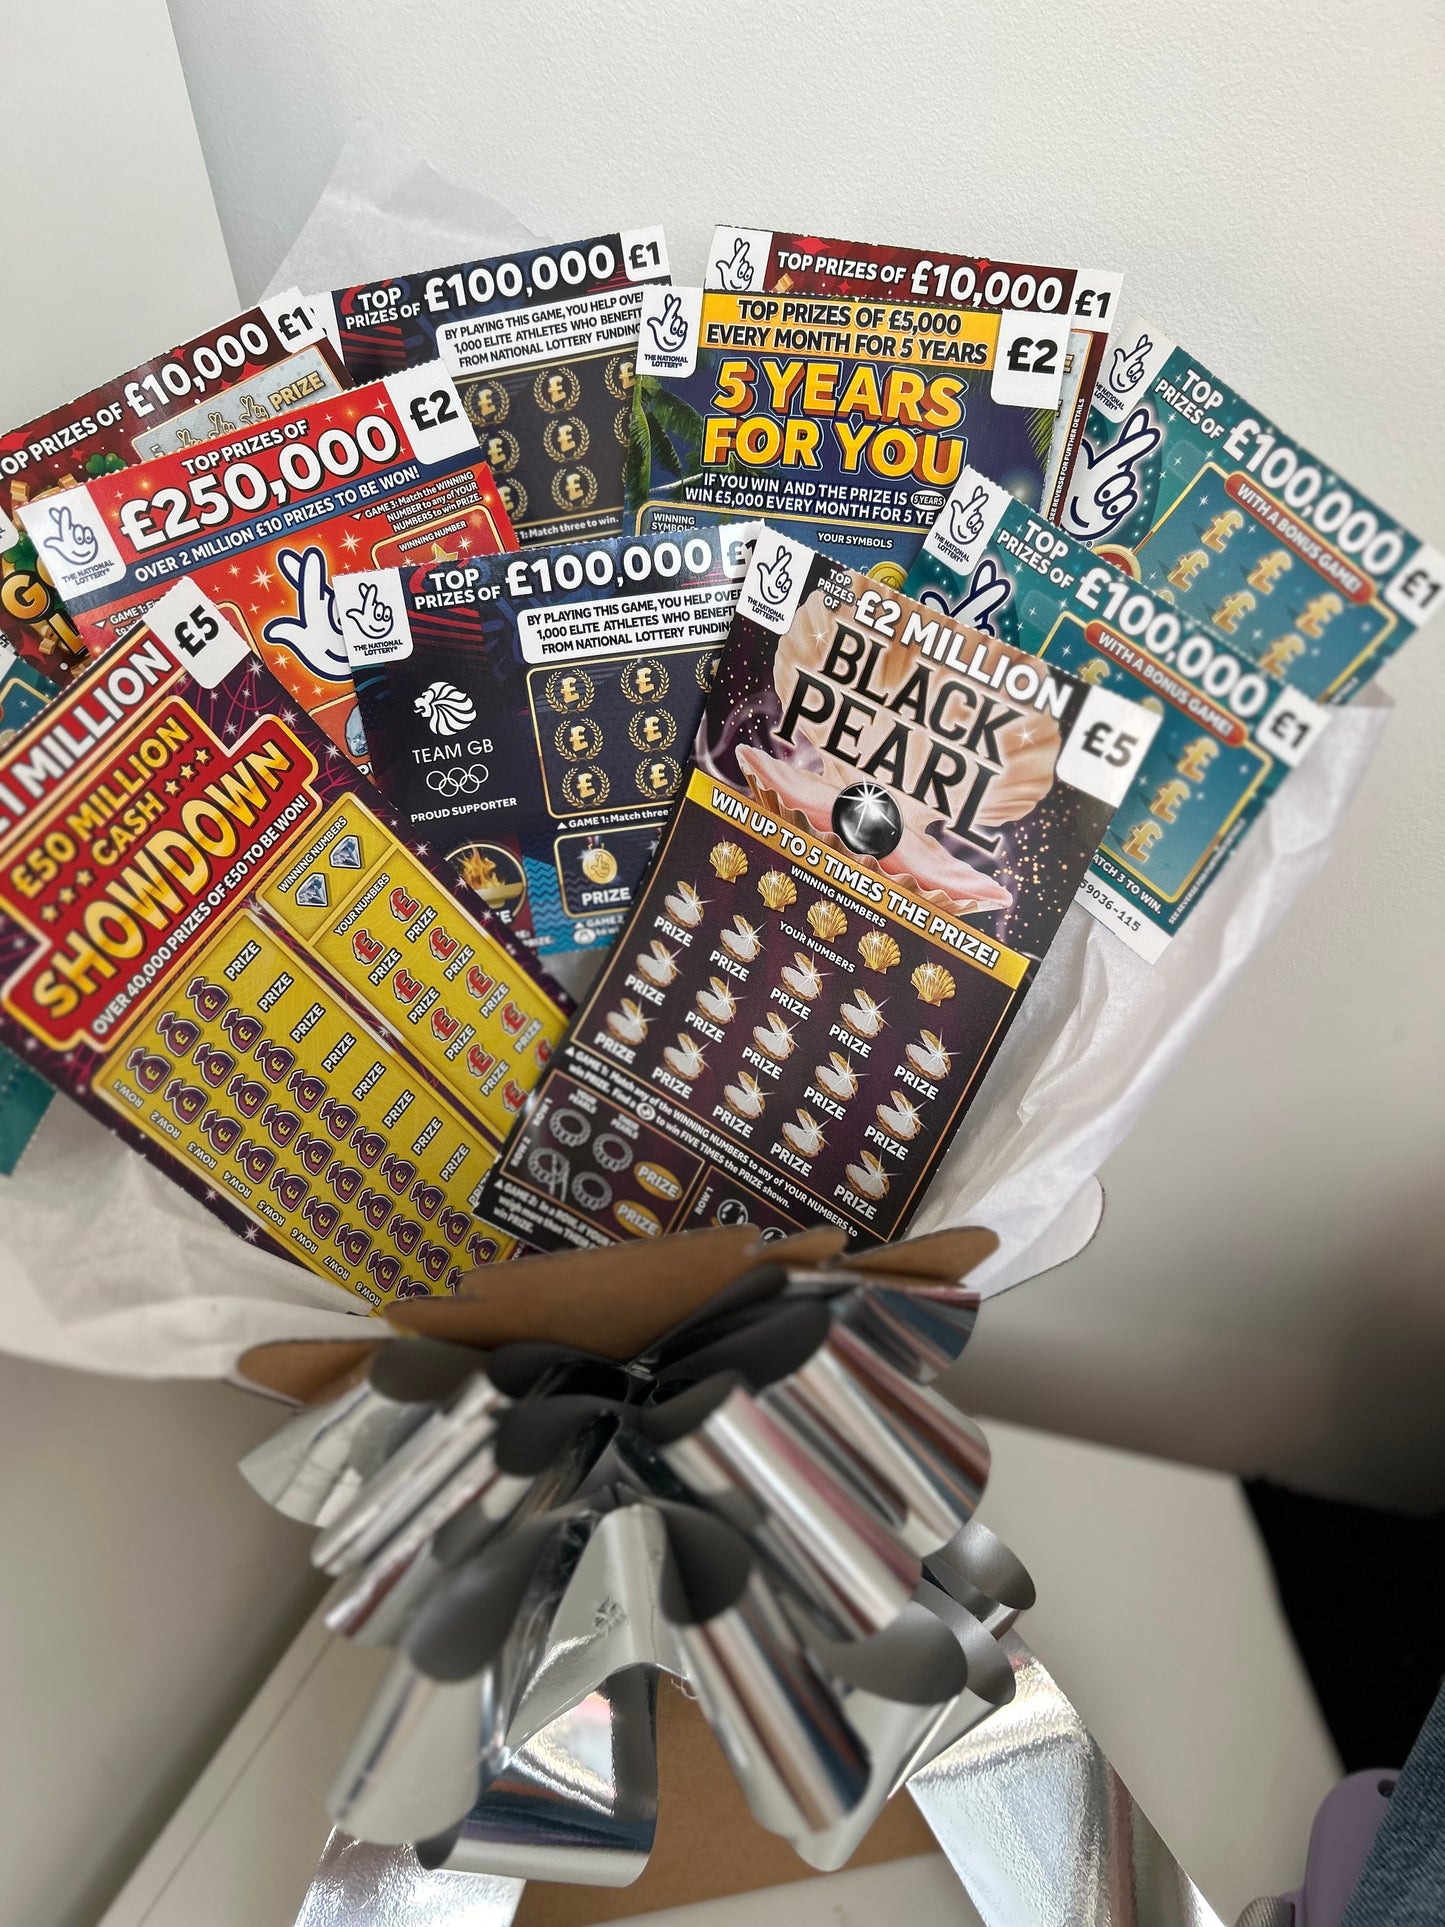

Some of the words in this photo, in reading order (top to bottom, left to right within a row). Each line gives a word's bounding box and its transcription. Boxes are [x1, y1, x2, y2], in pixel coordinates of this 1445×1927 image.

[629, 242, 660, 269] £1
[424, 245, 615, 312] £100,000
[777, 251, 813, 272] TOP
[814, 256, 878, 280] PRIZES
[881, 266, 907, 284] OF
[911, 260, 1063, 311] £10,000
[1074, 289, 1111, 318] £1
[345, 309, 398, 330] PRIZES
[357, 288, 402, 311] TOP
[400, 303, 420, 318] OF
[738, 299, 778, 321] TOP
[782, 303, 850, 326] PRIZES
[856, 307, 885, 328] OF
[889, 310, 961, 335] £5,000
[706, 324, 770, 346] EVERY
[774, 328, 850, 353] MONTH
[855, 334, 896, 355] FOR
[900, 339, 913, 356] 5
[919, 338, 987, 364] YEARS
[1006, 336, 1058, 375] £2
[28, 417, 98, 461] PRIZES
[96, 403, 123, 427] OF
[124, 323, 268, 418] £10,000
[277, 307, 313, 341] £1
[268, 371, 325, 411] PRIZE
[714, 360, 760, 416] 5
[759, 361, 969, 430] YEARS
[1154, 378, 1201, 424] PRIZES
[1184, 369, 1223, 409] TOP
[181, 451, 221, 476] TOP
[221, 433, 284, 465] PRIZES
[283, 419, 309, 440] OF
[1201, 416, 1225, 440] OF
[119, 415, 399, 552] £250,000
[409, 390, 459, 432] £2
[703, 415, 823, 468] FOR
[828, 420, 967, 487] YOU
[1049, 502, 1057, 521] SEE
[1053, 474, 1065, 506] REVERSE
[1064, 430, 1076, 461] FURTHER
[1073, 399, 1084, 430] DETAILS
[365, 505, 390, 518] GAME
[400, 493, 424, 506] Match
[424, 488, 436, 496] the
[436, 472, 474, 490] WINNING
[704, 473, 716, 486] IF
[719, 474, 748, 489] YOU
[751, 478, 780, 493] WIN
[784, 481, 816, 496] AND
[819, 483, 847, 500] THE
[850, 488, 889, 505] PRIZE
[892, 491, 907, 505] IS
[1222, 418, 1403, 577] £100,000
[134, 556, 177, 584] OVER
[178, 552, 191, 567] 2
[192, 529, 253, 563] MILLION
[255, 518, 283, 541] £10
[284, 495, 334, 530] PRIZES
[334, 489, 357, 509] TO
[358, 481, 379, 499] BE
[379, 466, 420, 490] WON!
[399, 535, 434, 552] WINNING
[434, 521, 466, 539] NUMBER
[818, 532, 846, 544] YOUR
[846, 535, 893, 549] SYMBOLS
[1025, 520, 1069, 560] TOP
[505, 539, 712, 597] £100,000
[996, 530, 1049, 578] PRIZES
[430, 568, 480, 590] TOP
[478, 586, 501, 601] OF
[817, 577, 855, 604] PRIZES
[829, 567, 852, 585] TOP
[1049, 566, 1075, 589] OF
[1401, 568, 1441, 608] £1
[414, 590, 475, 610] PRIZES
[527, 615, 542, 626] BY
[544, 608, 592, 624] PLAYING
[593, 605, 619, 616] THIS
[621, 601, 658, 613] GAME,
[658, 597, 681, 609] YOU
[683, 594, 712, 605] HELP
[823, 595, 840, 609] OF
[855, 590, 902, 638] £2
[537, 626, 567, 640] 1,000
[569, 622, 600, 635] ELITE
[603, 615, 658, 631] ATHLETES
[661, 611, 690, 622] WHO
[541, 641, 576, 654] FROM
[576, 634, 632, 651] NATIONAL
[636, 628, 684, 642] LOTTERY
[1074, 566, 1269, 717] £100,000
[899, 612, 1073, 721] MILLION
[1098, 632, 1135, 663] WITH
[1132, 659, 1143, 672] A
[1143, 665, 1190, 704] BONUS
[10, 639, 172, 799] MILLION
[174, 604, 219, 658] £5
[820, 622, 1029, 766] BLACK
[1082, 721, 1138, 768] £5
[1269, 709, 1312, 747] £1
[412, 744, 462, 764] TEAM
[467, 739, 494, 754] GB
[775, 668, 1005, 852] PEARL
[10, 831, 75, 899] £50
[67, 716, 191, 841] MILLION
[92, 789, 166, 865] CASH
[410, 807, 450, 824] PROUD
[451, 798, 517, 817] SUPPORTER
[278, 854, 313, 894] WINNING
[309, 816, 348, 859] NUMBERS
[33, 741, 292, 1019] SHOWDOWN
[582, 887, 631, 906] PRIZE
[711, 788, 752, 824] WIN
[751, 812, 778, 837] UP
[778, 827, 807, 856] TO
[806, 844, 821, 867] 5
[824, 855, 884, 902] TIMES
[887, 889, 928, 929] THE
[928, 916, 1000, 968] PRIZE!
[791, 865, 837, 899] WINNING
[835, 892, 887, 928] NUMBERS
[1092, 853, 1119, 879] ATCH
[1117, 872, 1124, 883] 3
[1125, 877, 1140, 895] TO
[1140, 891, 1162, 914] WIN.
[92, 994, 132, 1035] OVER
[126, 947, 173, 999] 40,000
[167, 902, 212, 952] PRIZES
[208, 883, 227, 910] OF
[224, 860, 249, 892] £50
[243, 844, 264, 869] TO
[261, 827, 281, 851] BE
[274, 795, 309, 835] WON!
[334, 914, 358, 937] YOUR
[355, 874, 391, 919] NUMBERS
[406, 906, 437, 943] PRIZE
[653, 916, 694, 948] PRIZE
[778, 921, 807, 946] YOUR
[804, 936, 856, 973] NUMBERS
[444, 946, 474, 980] PRIZE
[708, 949, 751, 982] PRIZE
[258, 972, 294, 1011] PRIZE
[323, 1034, 356, 1072] PRIZE
[828, 1024, 873, 1059] PRIZE
[655, 1116, 666, 1126] to
[665, 1121, 680, 1135] win
[680, 1130, 699, 1148] FIVE
[699, 1141, 724, 1164] TIMES
[724, 1160, 738, 1173] the
[738, 1169, 763, 1190] PRIZE
[762, 1184, 790, 1208] shown.
[230, 1178, 252, 1199] ROW
[833, 1184, 877, 1221] PRIZE
